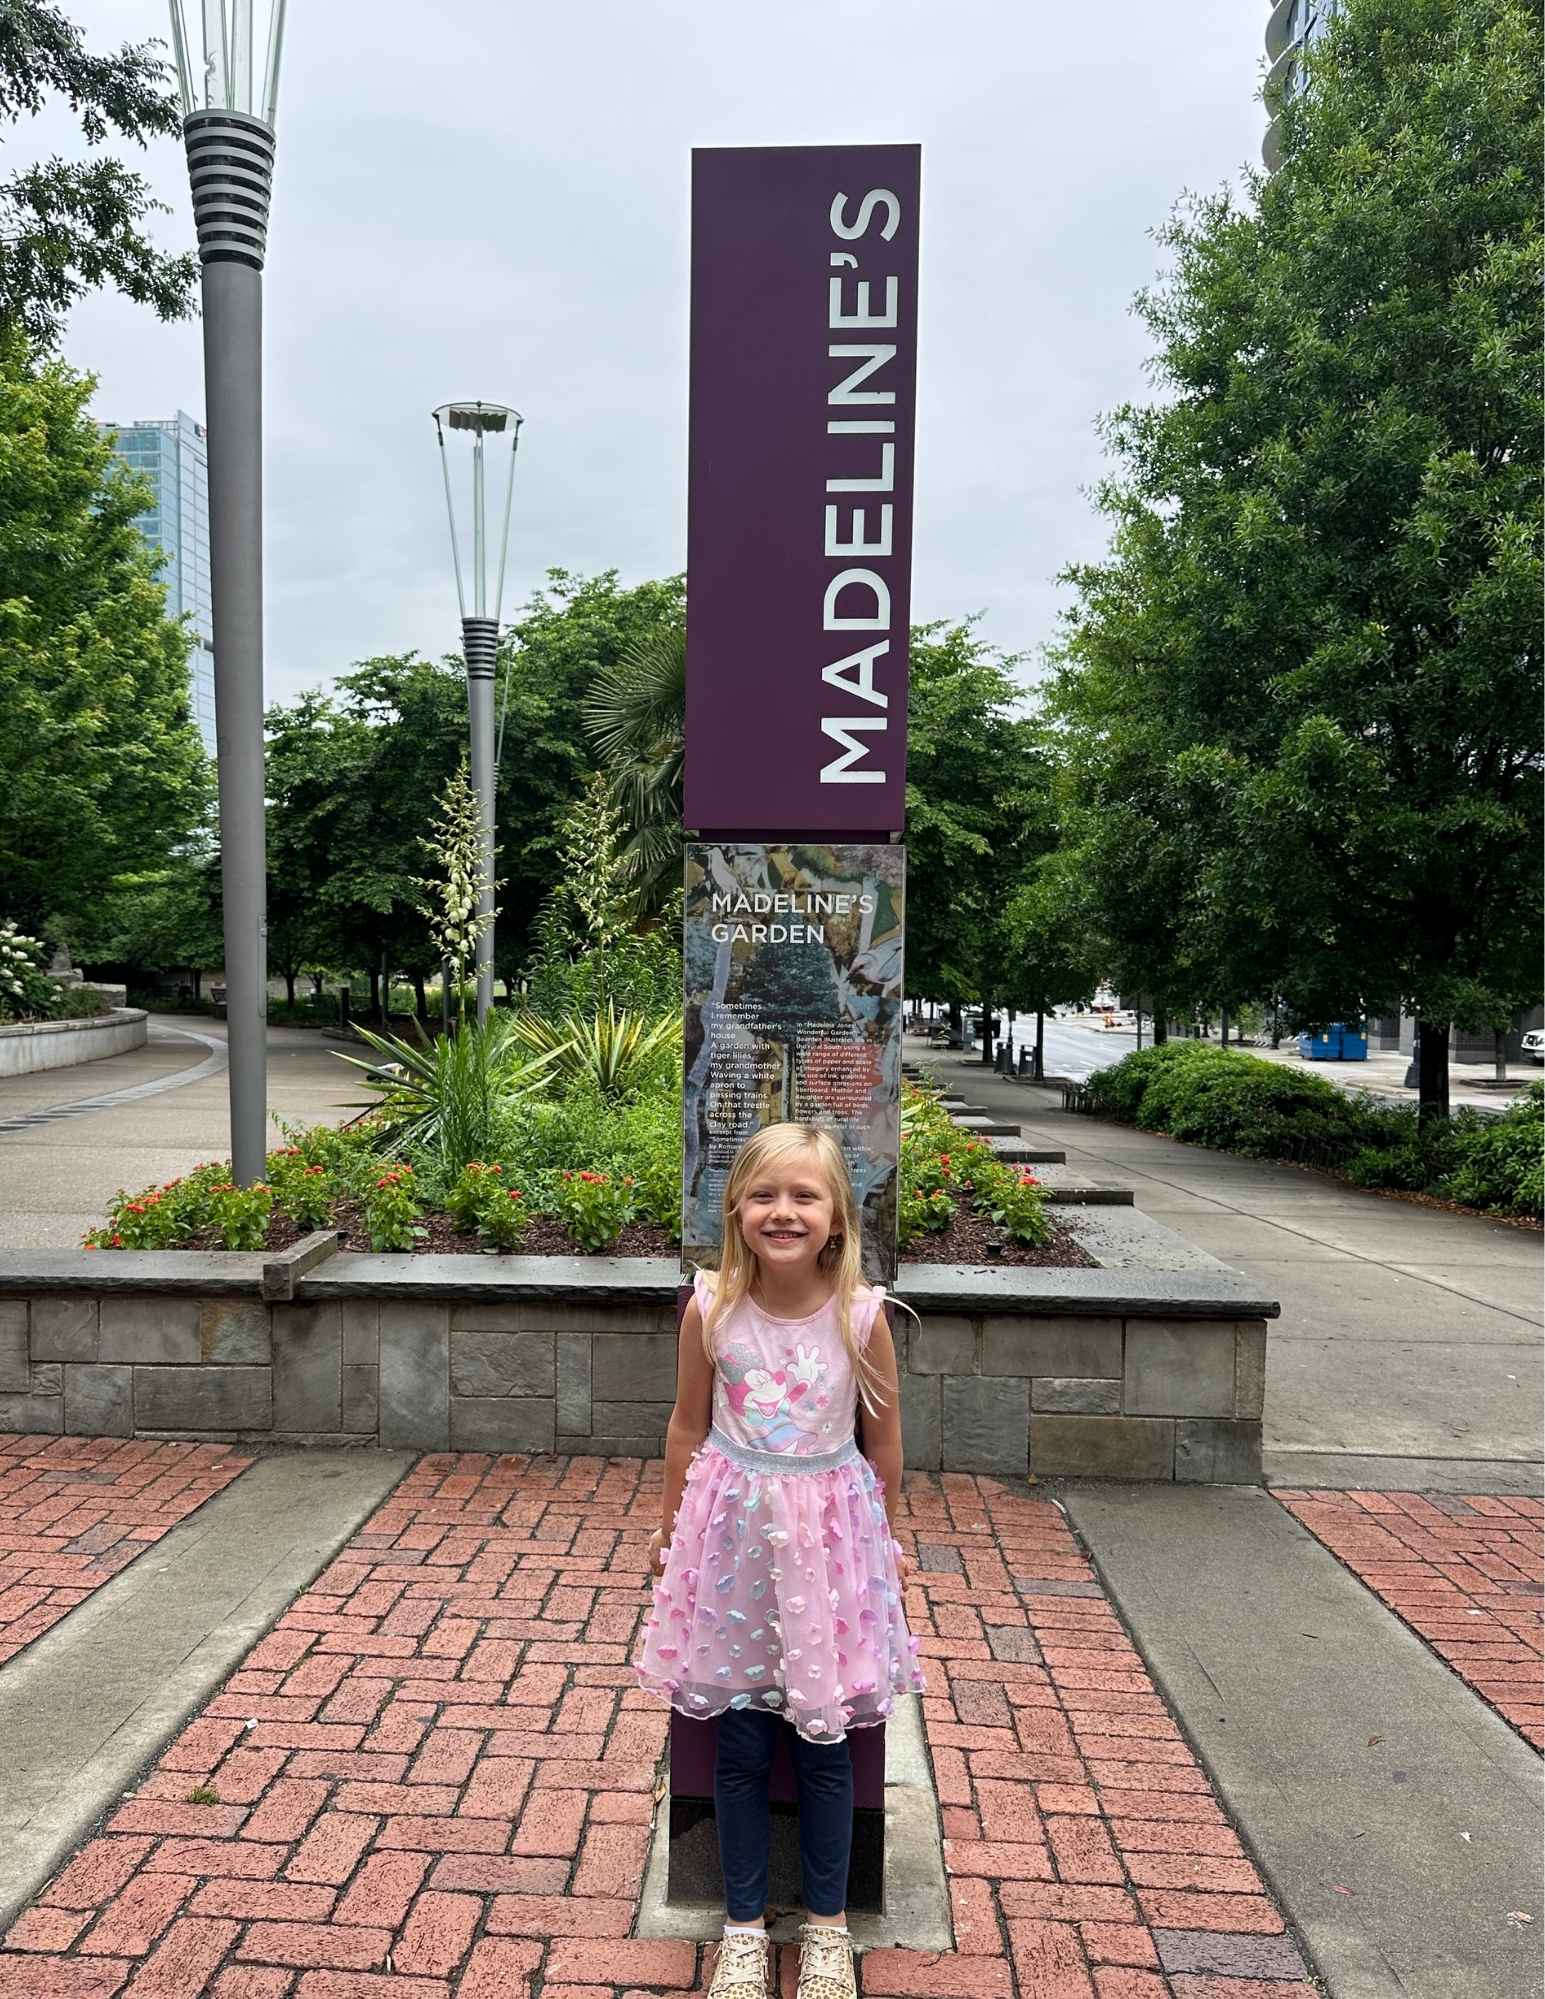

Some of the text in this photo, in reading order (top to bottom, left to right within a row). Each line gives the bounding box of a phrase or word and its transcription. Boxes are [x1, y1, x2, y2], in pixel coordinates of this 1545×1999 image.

[820, 188, 901, 784] MADELINE'S
[711, 893, 874, 914] MADELINE'S
[711, 924, 825, 944] GARDEN
[716, 1012, 760, 1020] remember
[726, 1022, 782, 1031] grandfather's
[720, 1042, 750, 1050] garden
[710, 1052, 731, 1060] tiger
[726, 1062, 780, 1070] grandmother
[710, 1072, 742, 1080] Waving
[710, 1092, 742, 1100] passing
[710, 1122, 726, 1130] clay
